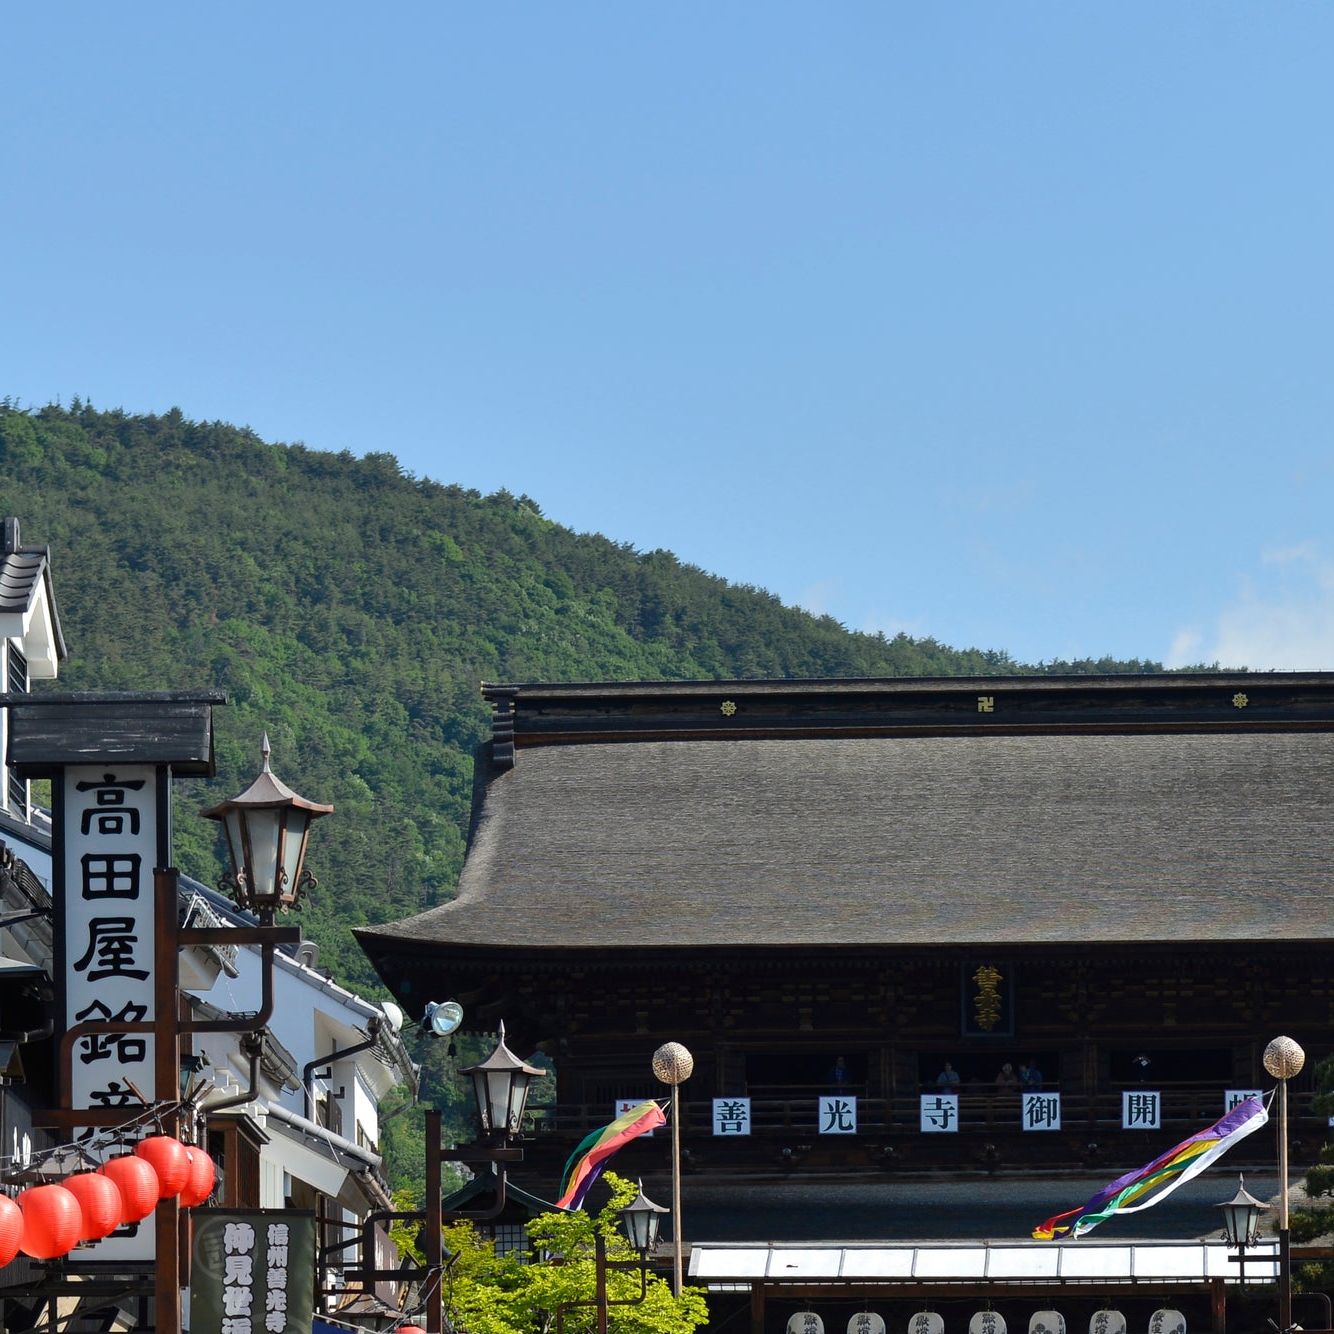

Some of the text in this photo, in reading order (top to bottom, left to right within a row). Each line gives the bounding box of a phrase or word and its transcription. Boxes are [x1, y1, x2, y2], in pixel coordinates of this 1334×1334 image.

[264, 1222, 290, 1334] 信州善光寺
